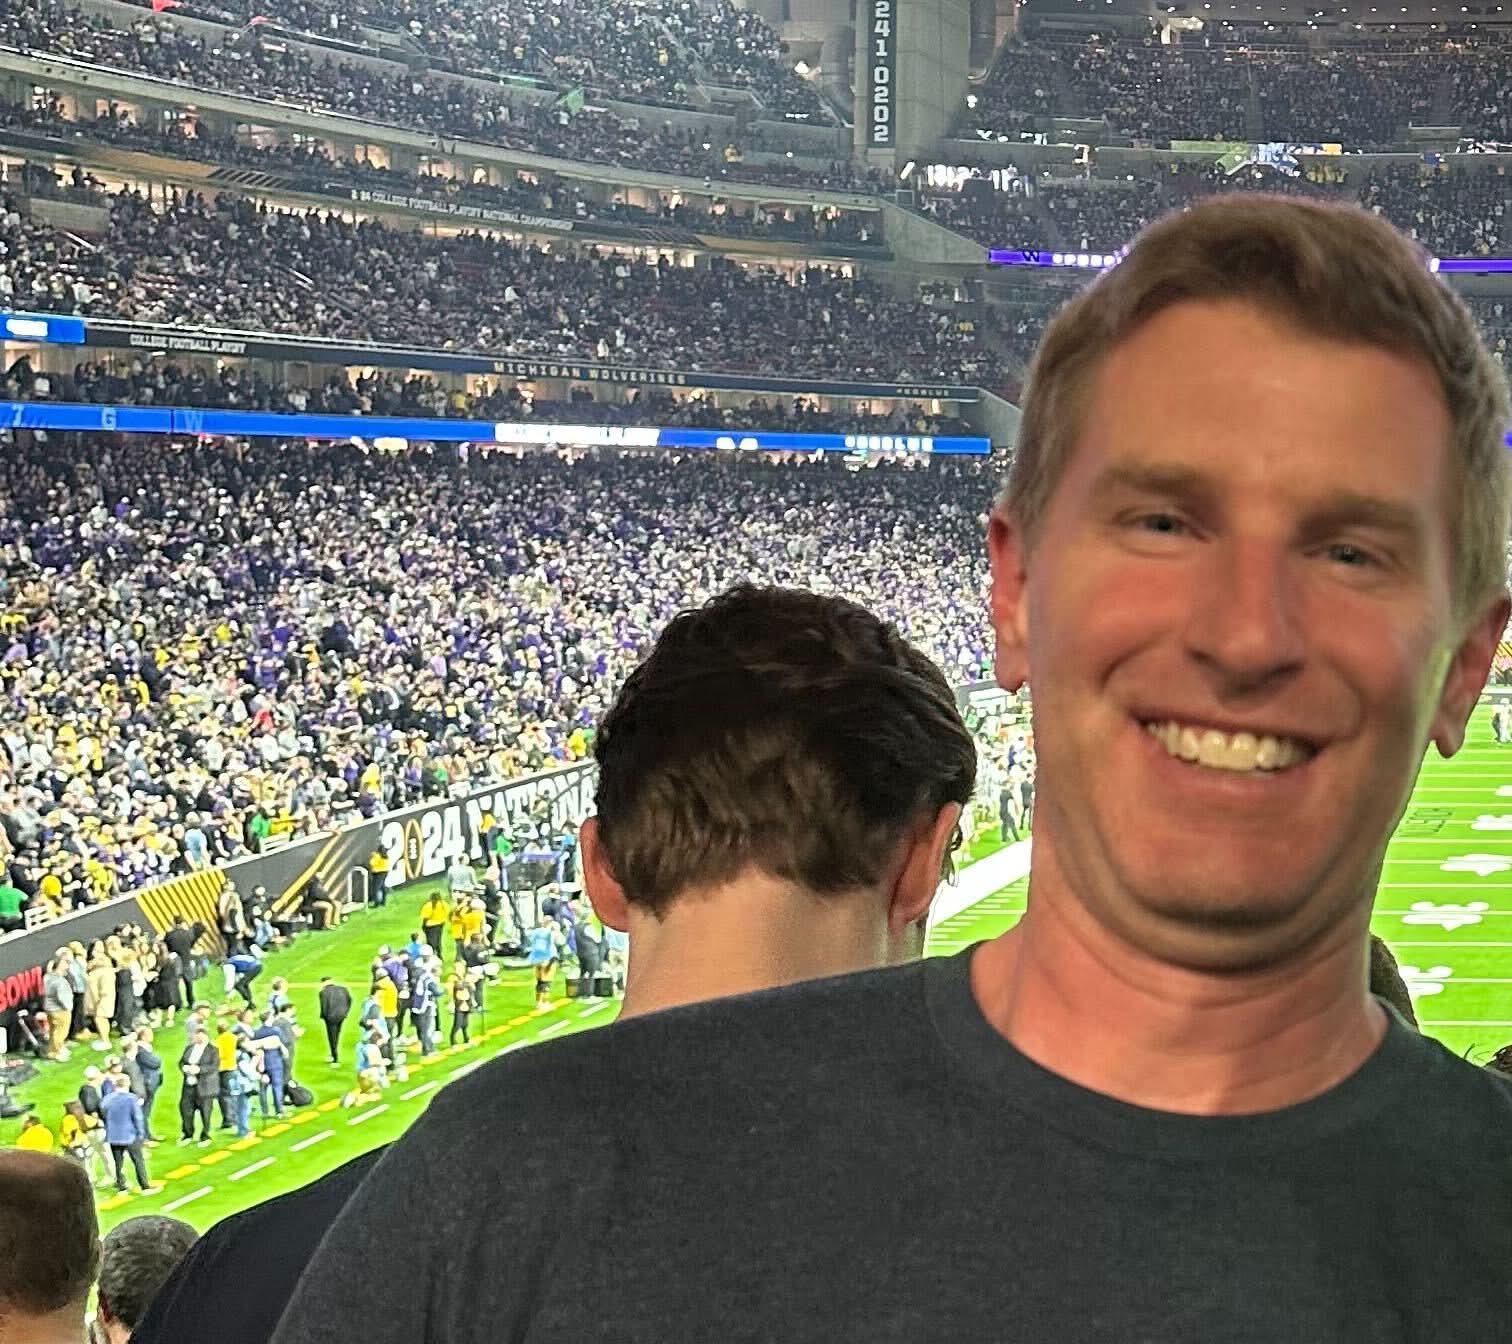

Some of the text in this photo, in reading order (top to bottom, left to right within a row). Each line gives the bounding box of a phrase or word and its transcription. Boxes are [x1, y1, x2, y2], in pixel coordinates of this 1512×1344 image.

[129, 334, 168, 348] COLLEGE
[169, 337, 211, 351] FOOTBALL
[494, 361, 686, 385] MICHIGAN WOLVERINES
